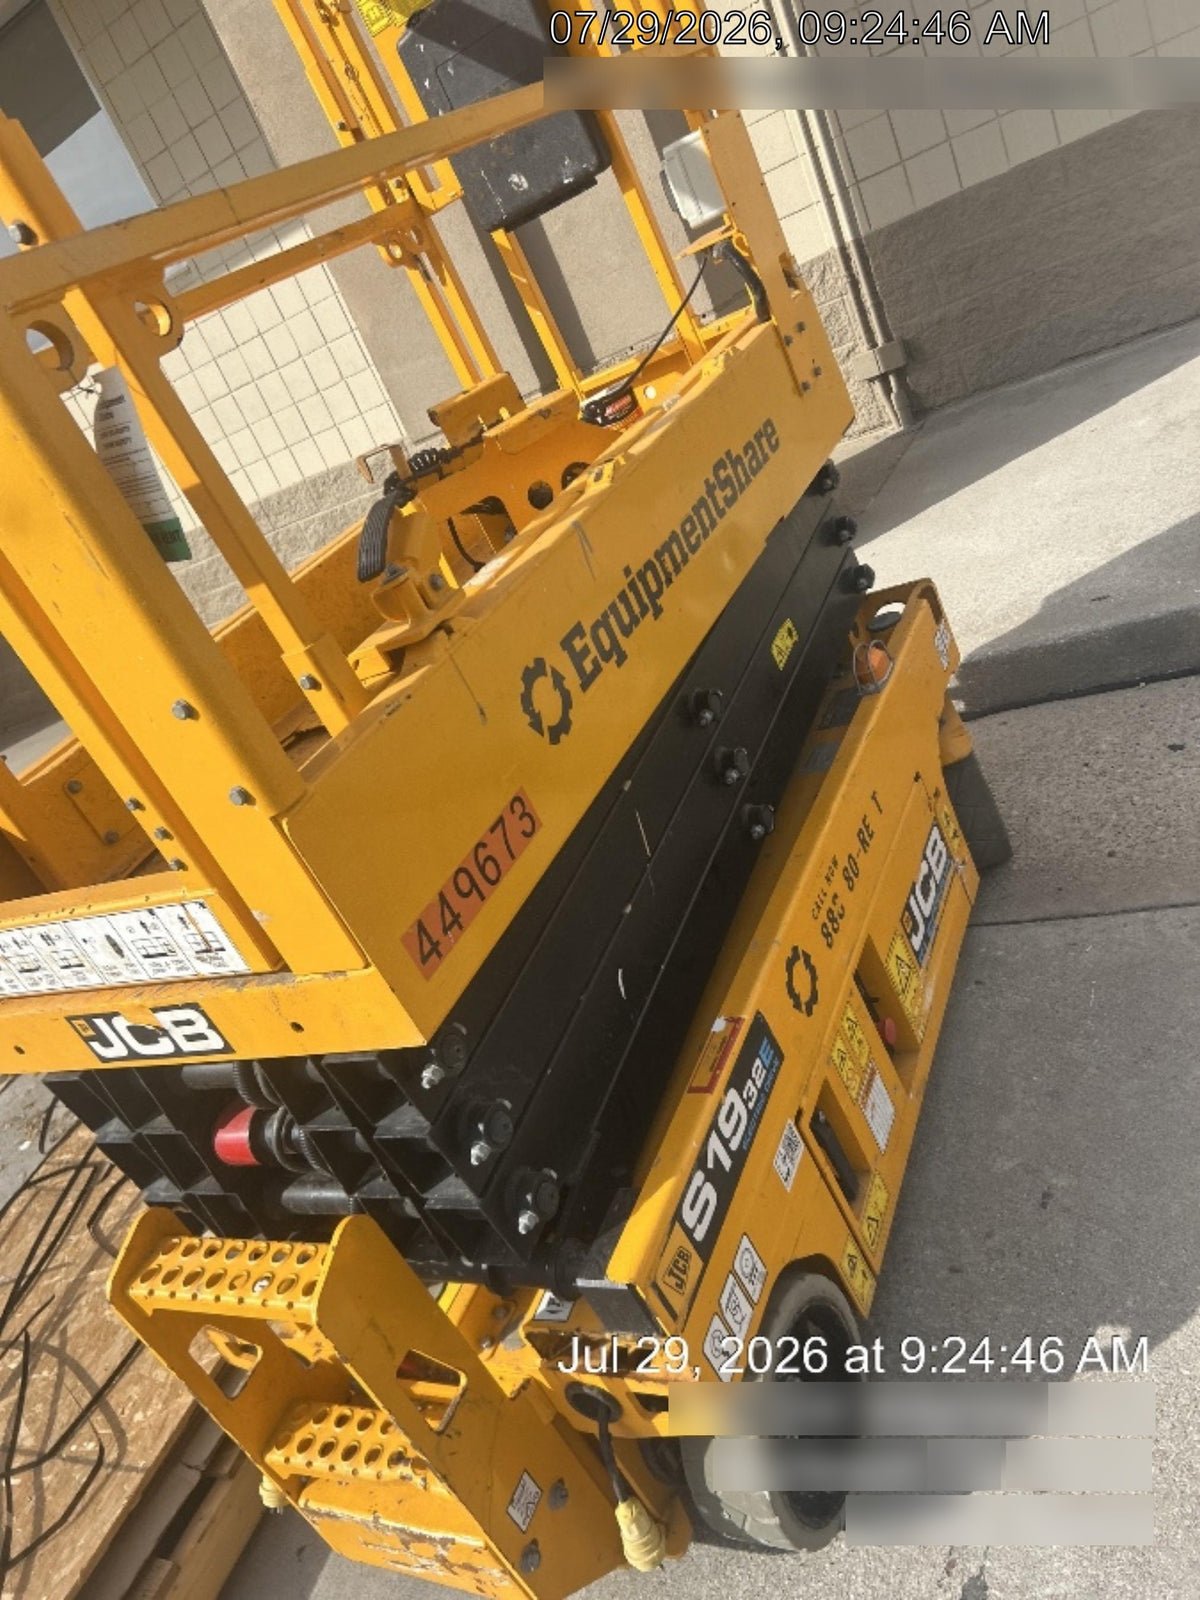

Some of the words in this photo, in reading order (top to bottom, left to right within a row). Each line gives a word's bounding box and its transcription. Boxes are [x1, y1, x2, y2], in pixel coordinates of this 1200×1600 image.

[560, 418, 780, 693] EquipmentShare
[416, 796, 536, 966] 449673
[909, 825, 947, 952] JCB
[89, 1009, 225, 1058] JCB
[670, 1250, 691, 1290] JCB
